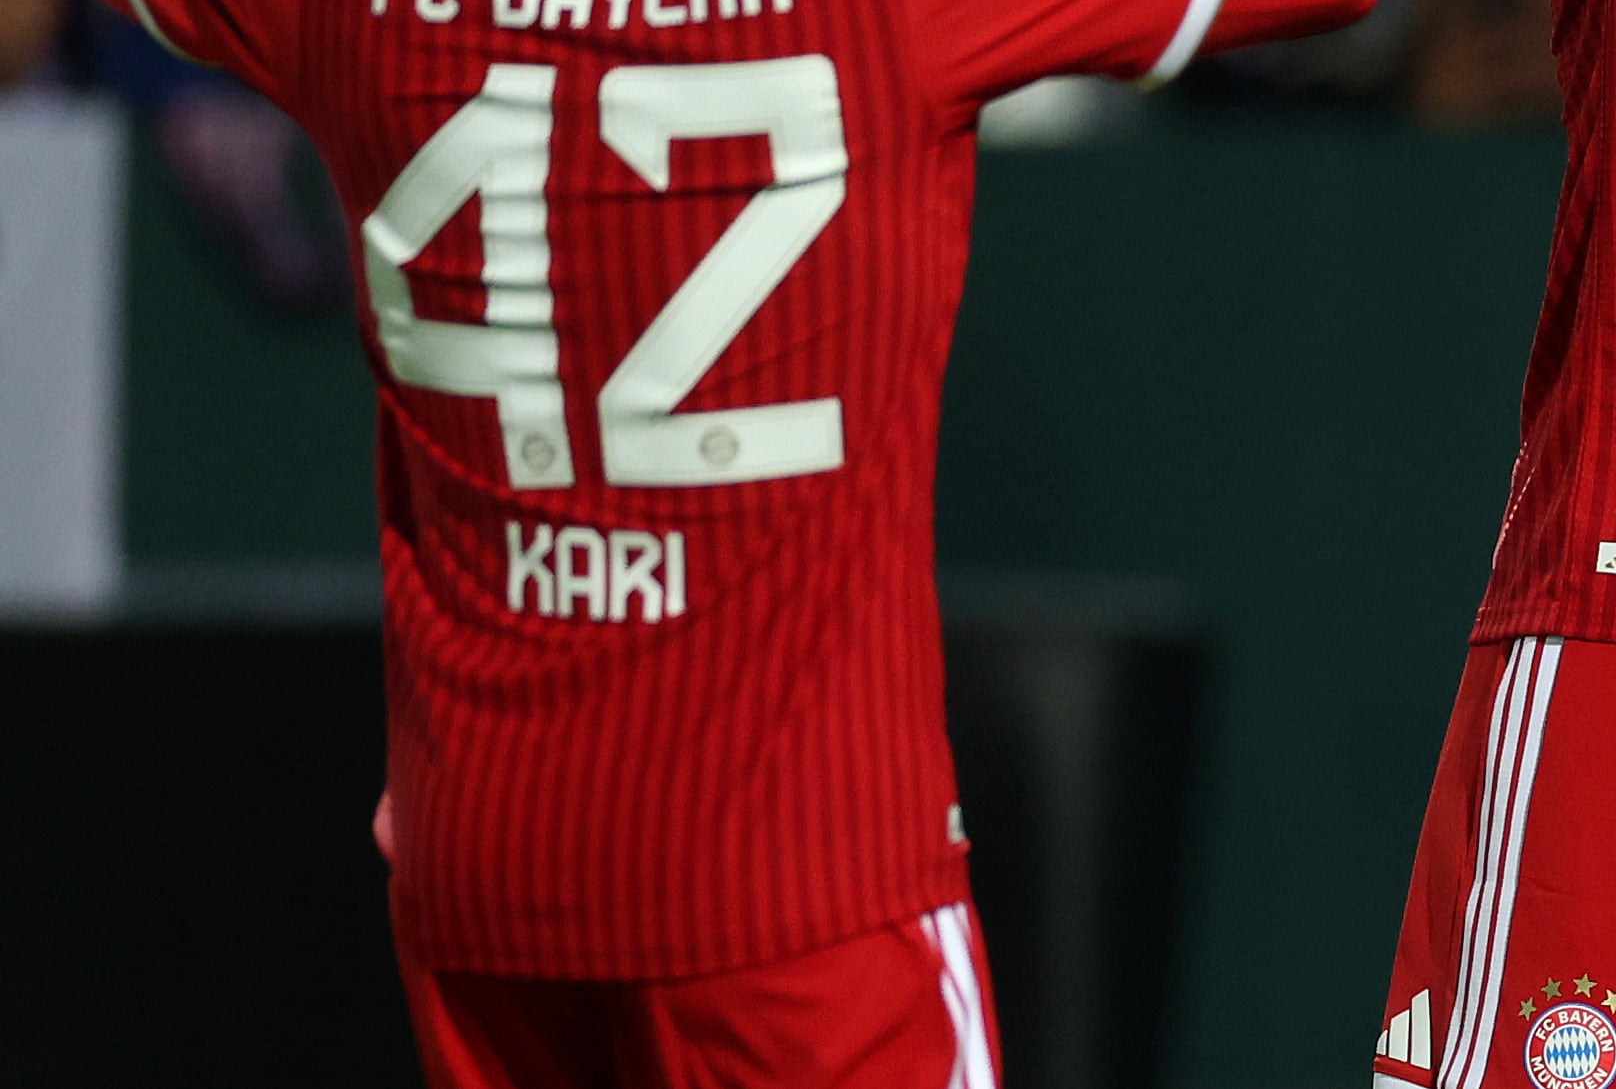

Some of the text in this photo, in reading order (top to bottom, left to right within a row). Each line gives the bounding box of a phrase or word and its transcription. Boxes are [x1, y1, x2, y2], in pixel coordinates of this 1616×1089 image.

[363, 55, 847, 490] 42
[506, 520, 686, 624] KARI
[1535, 1010, 1614, 1052] FC BAYERN
